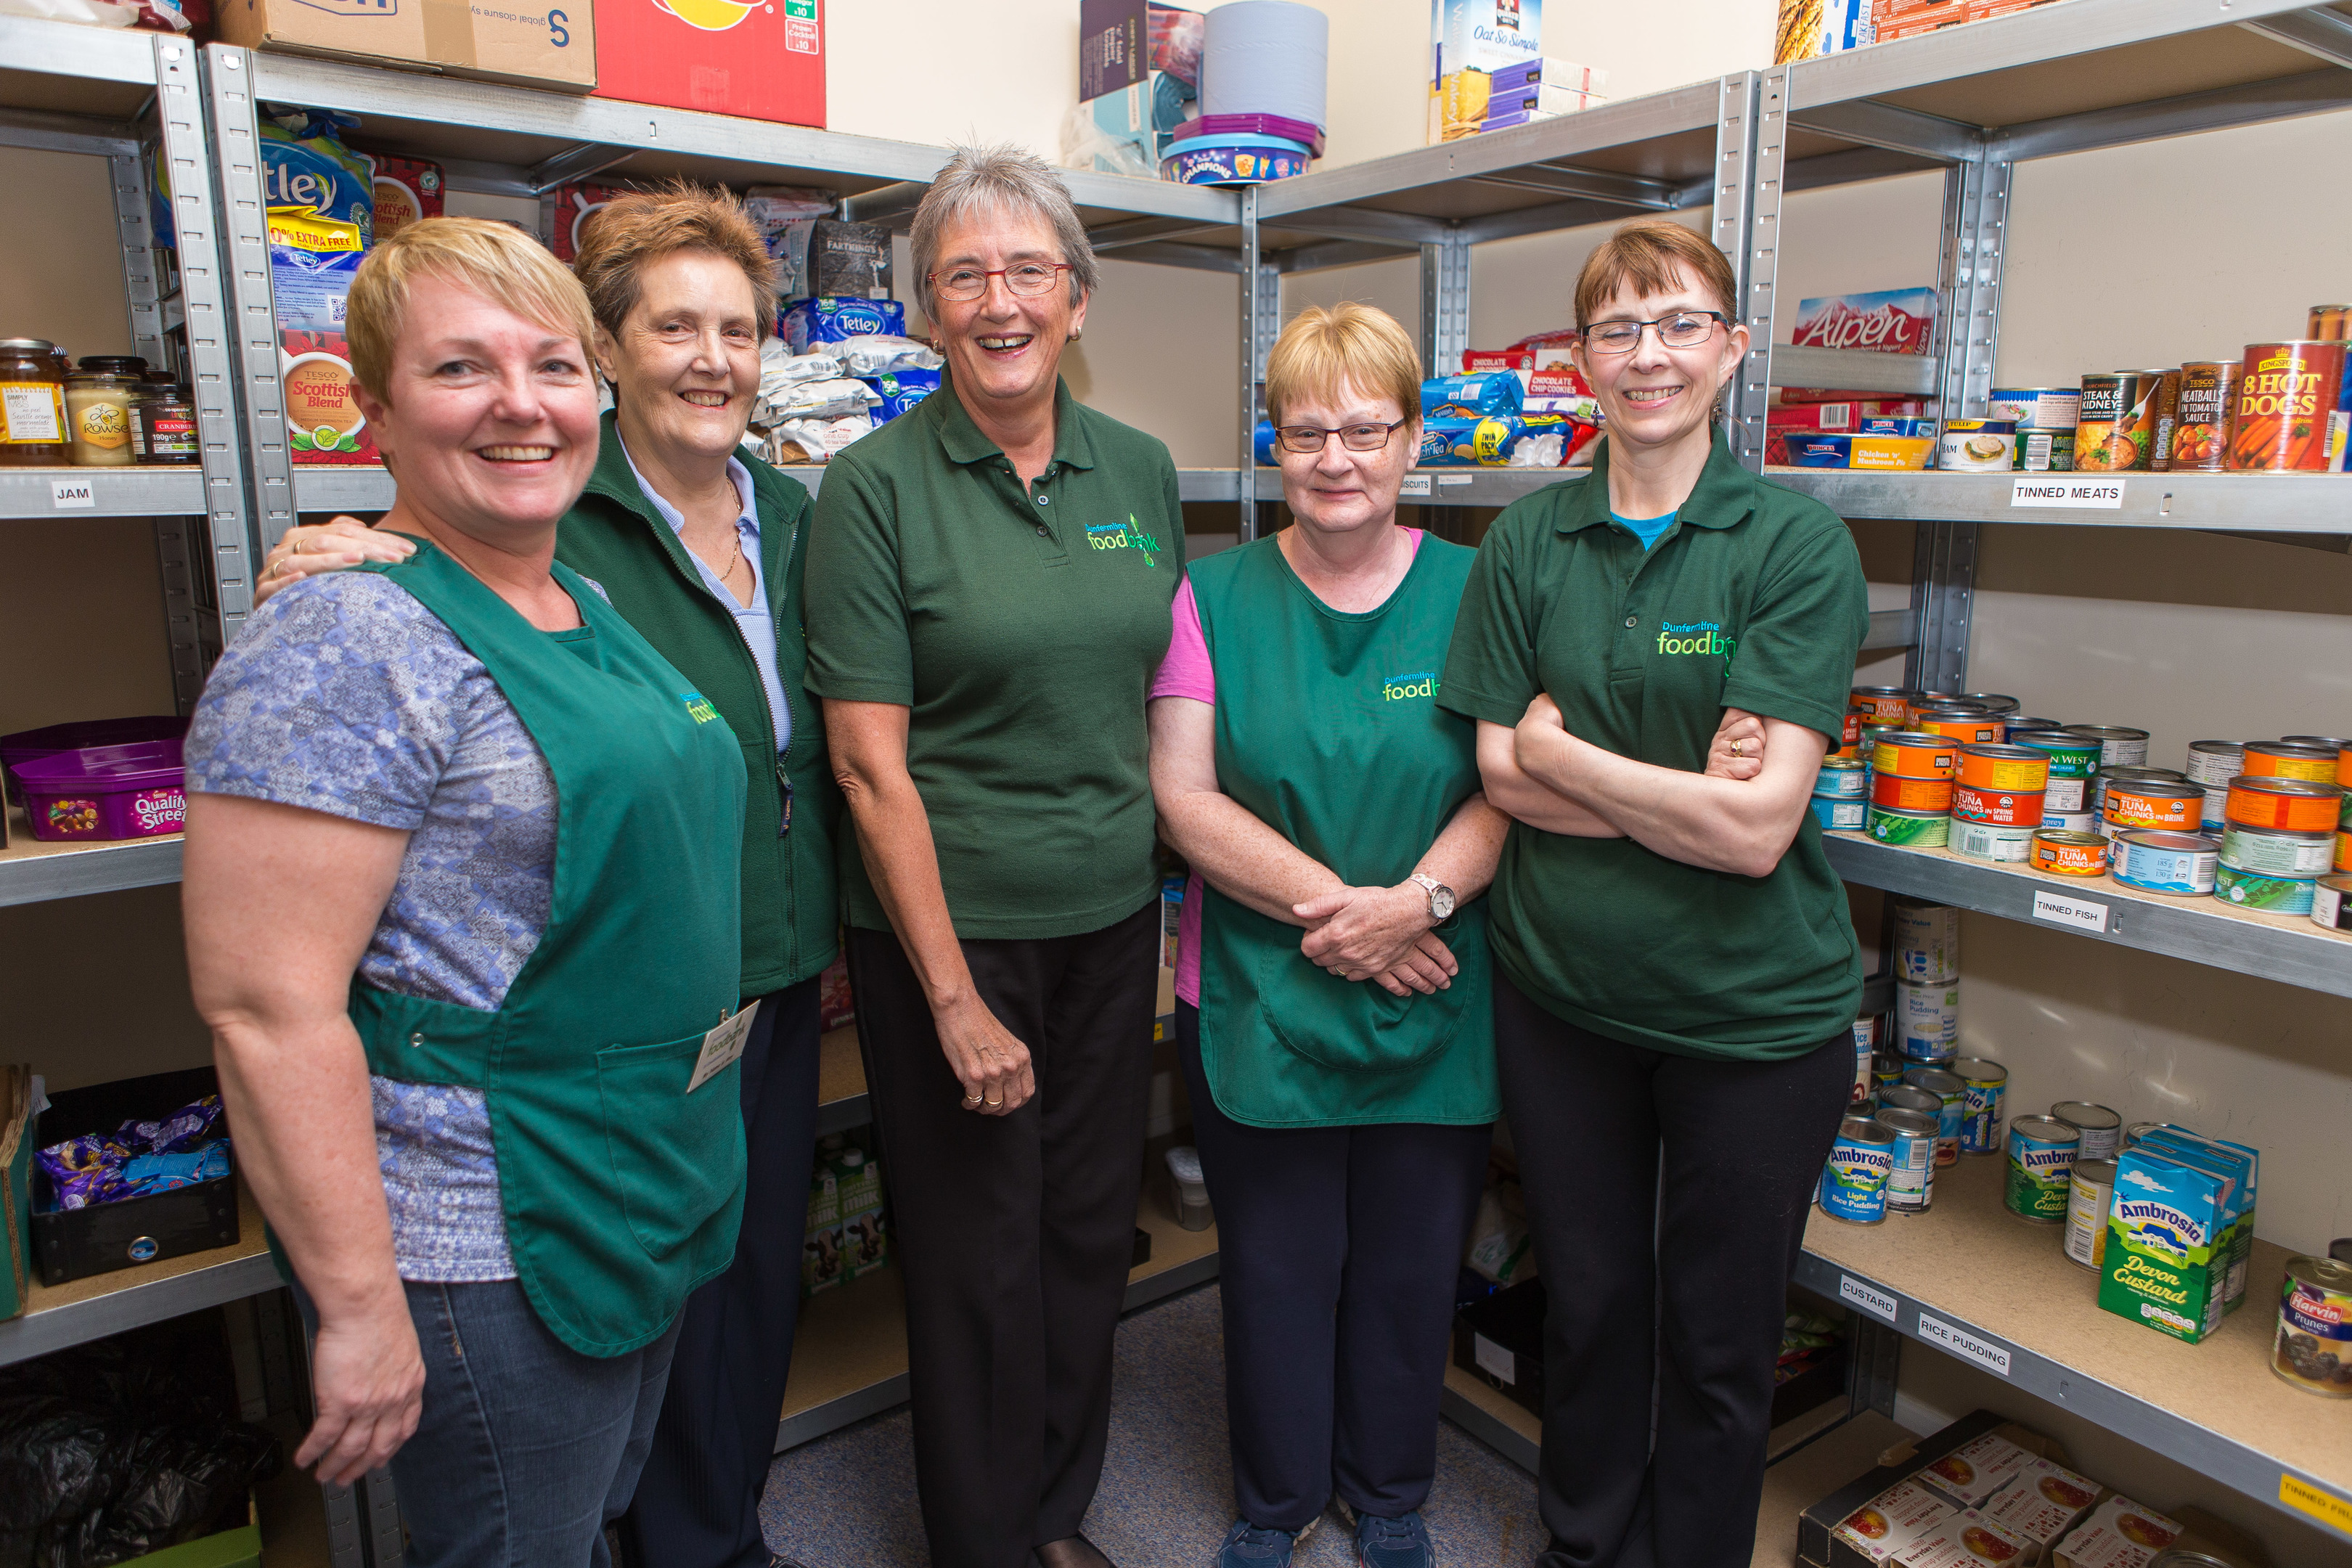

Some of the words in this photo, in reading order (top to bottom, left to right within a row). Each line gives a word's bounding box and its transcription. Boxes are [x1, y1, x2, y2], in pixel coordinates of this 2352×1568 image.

[483, 9, 517, 23] closure
[794, 7, 807, 17] x10
[519, 15, 546, 27] global
[788, 29, 816, 39] Cocktail
[1474, 25, 1494, 41] Oat
[1495, 30, 1508, 44] So
[1509, 33, 1539, 52] Simple
[796, 40, 809, 50] x10
[1182, 161, 1233, 184] CHAMPIONS
[296, 232, 327, 247] EXTRA
[328, 237, 352, 247] FREE
[293, 253, 318, 265] Tetley
[839, 315, 881, 335] Tetley
[1799, 302, 1911, 350] Alpen
[1473, 358, 1507, 367] CHOCOLATE
[2259, 359, 2304, 371] KINGSFOD
[303, 370, 340, 379] TESCO
[1532, 376, 1573, 385] CHOCOLATE
[1548, 385, 1577, 394] COOKIES
[2189, 378, 2215, 388] TESCO
[2242, 375, 2255, 395] 8
[2257, 373, 2322, 394] HOT
[2083, 390, 2111, 401] STEAK
[2112, 390, 2120, 400] &
[2181, 389, 2224, 403] MEATBALLS
[306, 396, 344, 409] Blend
[2081, 399, 2119, 410] KIDNEY
[2181, 404, 2189, 413] IN
[2189, 403, 2220, 413] TOMATO
[2239, 395, 2316, 417] DOGS
[2184, 413, 2211, 422] SAUCE
[1482, 433, 1495, 441] TWIN
[1432, 438, 1445, 453] Tea
[1482, 441, 1495, 450] PACK
[1940, 443, 1958, 454] HAM
[1858, 449, 1890, 459] Chicken
[57, 488, 90, 499] JAM
[2016, 486, 2065, 499] TINNED
[2070, 487, 2119, 499] MEATS
[1085, 522, 1127, 533] Dunfermline
[1662, 621, 1720, 632] Dunfermline
[1384, 671, 1436, 685] Dunfermline
[1877, 704, 1904, 713] TUNA
[2049, 754, 2059, 763] N
[2062, 755, 2088, 764] WEST
[1959, 788, 1975, 797] SKIPJACK
[135, 795, 188, 814] Quality
[1958, 793, 1983, 806] TUNA
[1957, 802, 1983, 813] CHUNKS
[2121, 801, 2153, 813] TUNA
[142, 809, 187, 830] Street
[1993, 814, 2014, 822] WATER
[2119, 809, 2155, 820] CHUNKS
[2164, 813, 2185, 822] BRINE
[2058, 851, 2088, 862] TUNA
[2057, 859, 2088, 868] CHUNKS
[2036, 900, 2072, 917] TINNED
[2073, 909, 2099, 922] FISH
[1908, 1005, 1940, 1015] Pudding
[1830, 1148, 1892, 1171] Ambrosia
[843, 1189, 880, 1214] milk
[1832, 1194, 1847, 1206] Rice
[1848, 1197, 1880, 1211] Pudding
[1847, 1191, 1868, 1202] Light
[2120, 1202, 2202, 1244] Ambrosia
[2123, 1255, 2181, 1286] Devon
[2112, 1267, 2187, 1305] Custard
[1842, 1281, 1894, 1312] CUSTARD
[2127, 1286, 2143, 1297] creamy
[2147, 1293, 2170, 1306] delicious
[2291, 1295, 2339, 1321] Harvin
[2294, 1312, 2329, 1332] Prunes
[2306, 1326, 2319, 1336] Syrup
[1921, 1319, 1948, 1340] RICE
[1952, 1334, 2006, 1367] PUDDING
[2284, 1482, 2327, 1508] TINNED
[1992, 1498, 2016, 1516] Everyday
[2012, 1488, 2027, 1501] Value
[1916, 1503, 1944, 1519] Everyday
[1903, 1515, 1922, 1528] Value
[1908, 1538, 1925, 1551] TESCO
[2069, 1537, 2094, 1556] Everyday
[2090, 1526, 2105, 1540] Value
[1905, 1545, 1934, 1563] Everyday
[1930, 1535, 1947, 1550] Value
[1934, 1543, 1959, 1561] pudding
